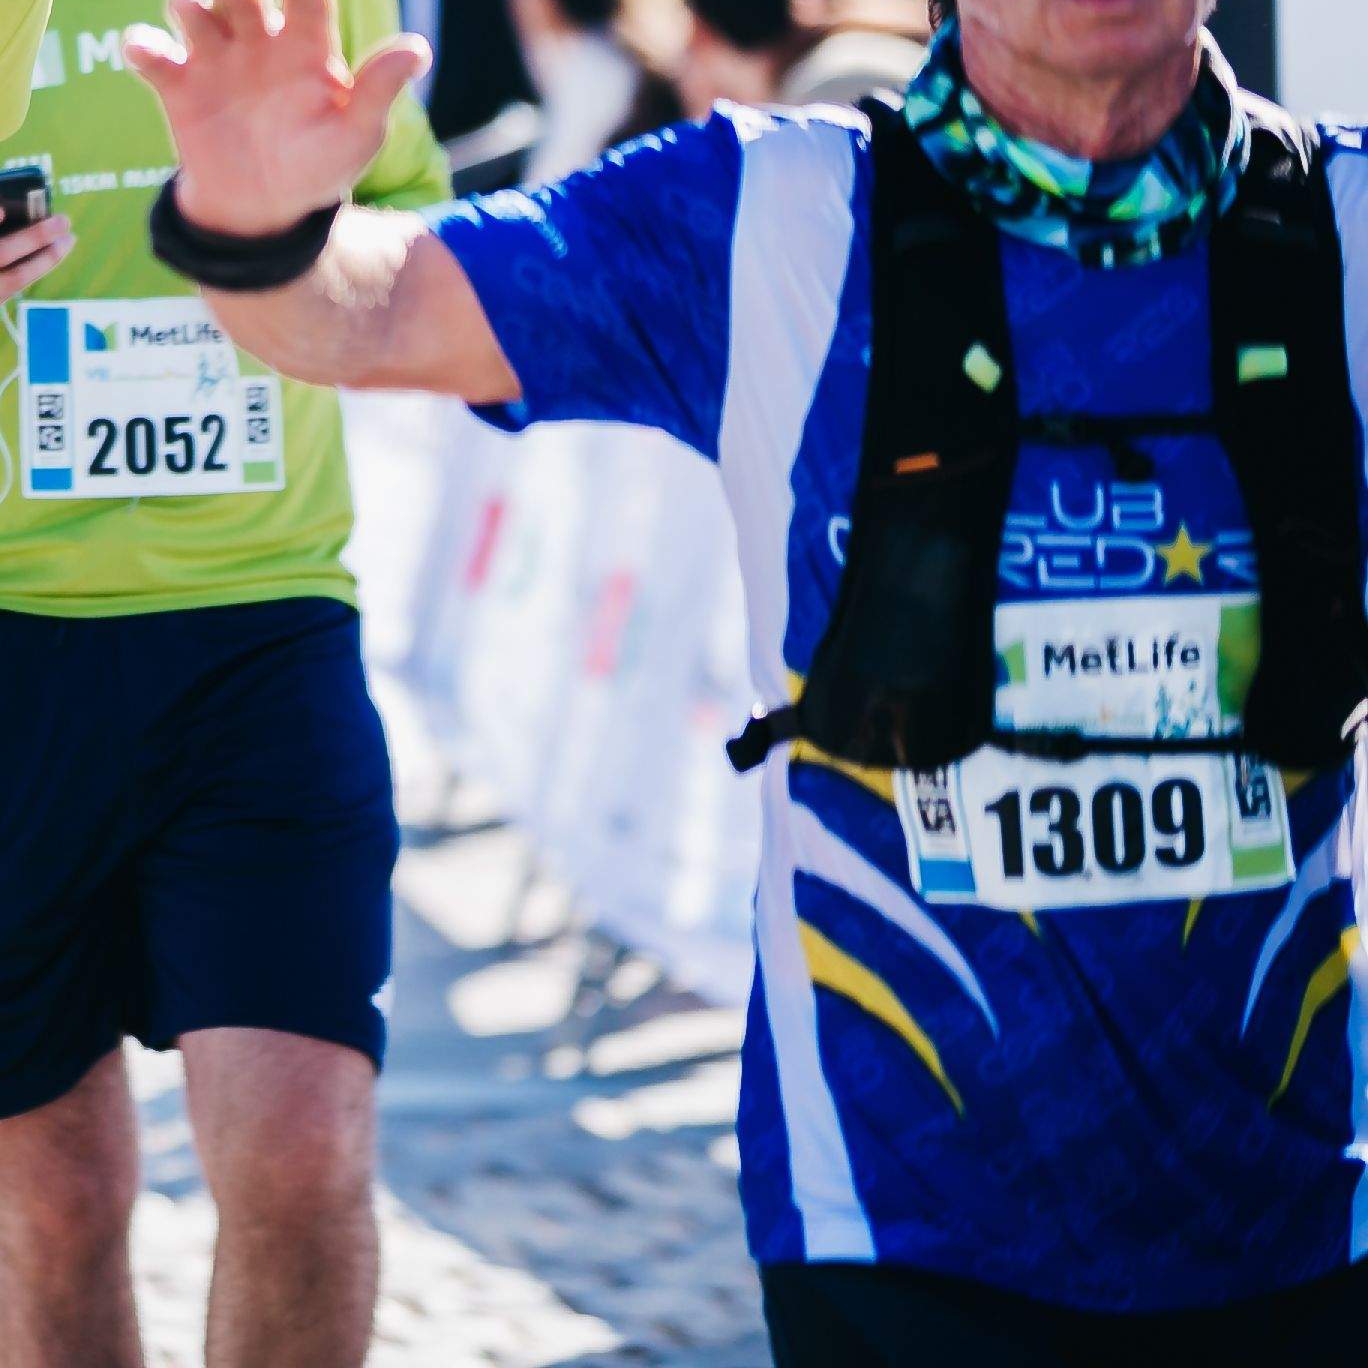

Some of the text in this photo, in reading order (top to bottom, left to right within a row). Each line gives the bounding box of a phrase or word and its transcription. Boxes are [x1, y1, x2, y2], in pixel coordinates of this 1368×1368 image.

[129, 323, 224, 347] MetLife
[87, 413, 230, 477] 2052
[1043, 633, 1202, 677] MetLife
[984, 777, 1206, 881] 1309
